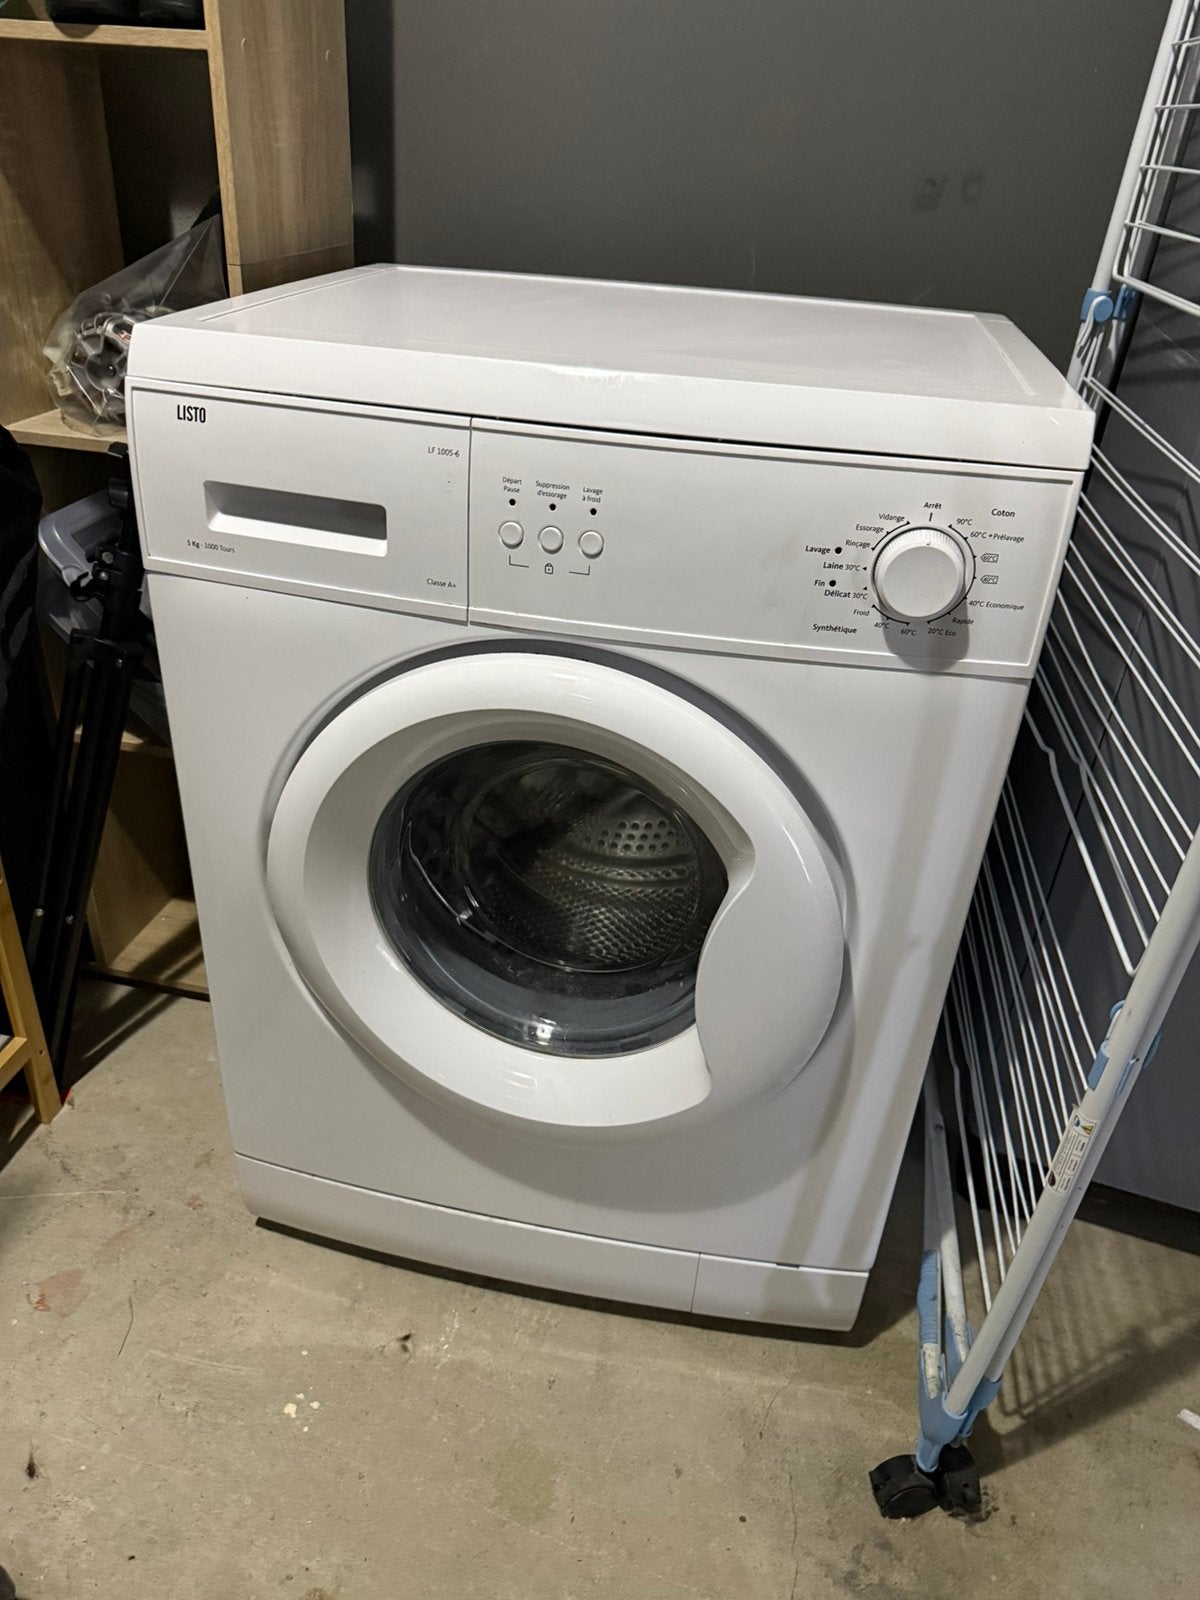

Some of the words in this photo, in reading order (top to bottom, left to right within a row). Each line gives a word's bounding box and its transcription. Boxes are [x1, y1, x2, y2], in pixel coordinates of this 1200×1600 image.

[177, 404, 206, 424] LISTO
[428, 446, 436, 455] LF
[437, 448, 460, 458] 1005-6
[502, 477, 522, 485] Départ
[535, 481, 570, 490] Suppression
[537, 490, 567, 499] d'essorage
[583, 487, 603, 495] Lavage
[923, 502, 942, 510] Arrêt
[879, 513, 905, 522] Vidange
[991, 509, 1015, 517] Coton
[855, 524, 885, 533] Essorage
[993, 533, 1024, 543] Prélavage
[192, 540, 200, 549] Kg
[204, 543, 218, 551] 1000
[219, 545, 235, 553] Tours
[845, 539, 871, 549] Rinçage
[805, 545, 831, 554] Lavage
[823, 562, 843, 570] Laine
[427, 578, 446, 588] Classe
[814, 579, 825, 587] Fin
[824, 590, 851, 599] Délicat
[986, 602, 1024, 611] Economique
[952, 617, 974, 626] Rapide
[813, 624, 857, 634] Synthétique
[901, 628, 916, 636] 60°C
[928, 627, 944, 635] 20°C
